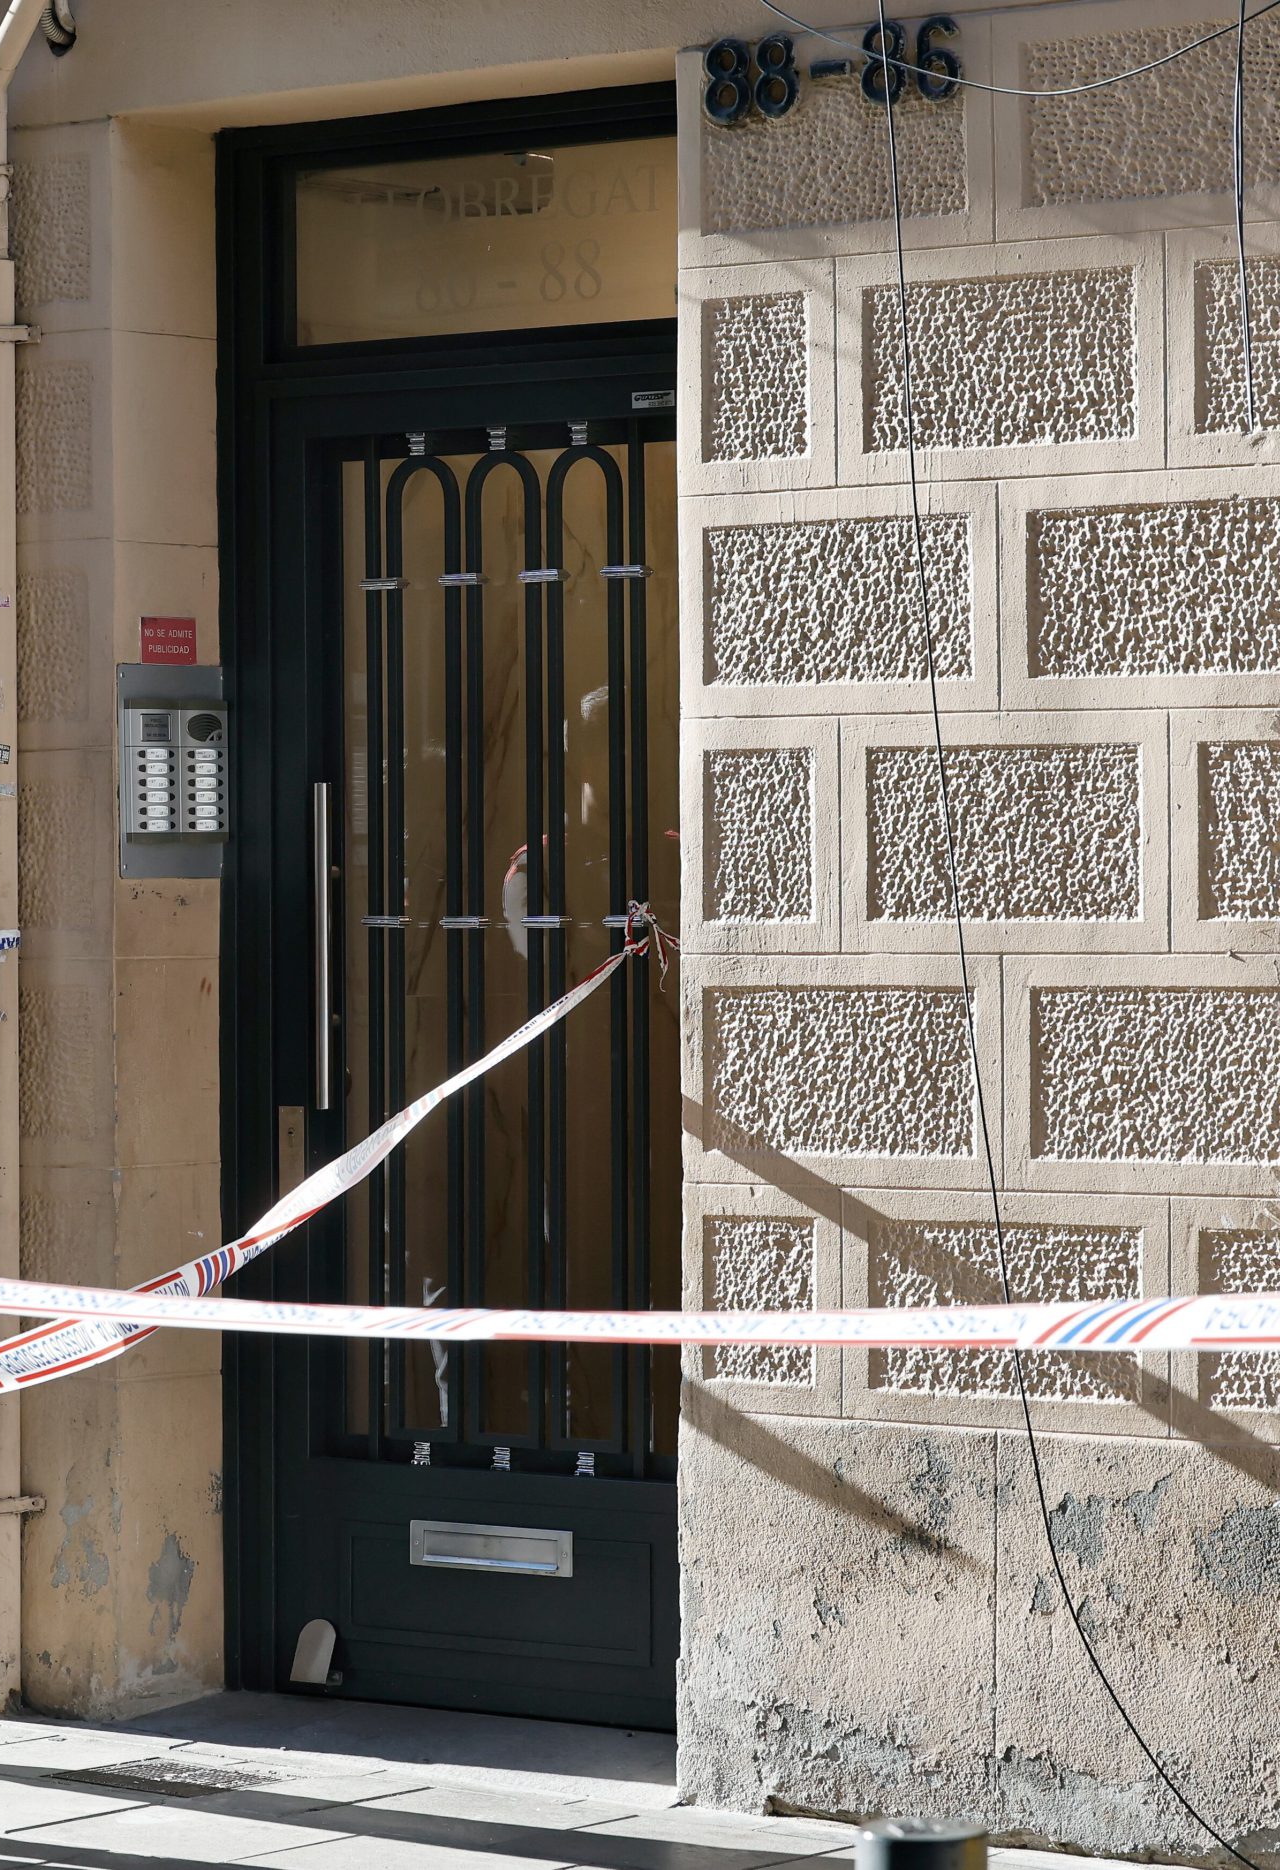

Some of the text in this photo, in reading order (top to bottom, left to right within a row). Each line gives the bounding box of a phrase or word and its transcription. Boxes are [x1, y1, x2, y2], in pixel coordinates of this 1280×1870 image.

[539, 239, 602, 303] 88
[144, 628, 193, 639] NO SE ADMITE
[148, 644, 190, 654] PUBLICIDAD
